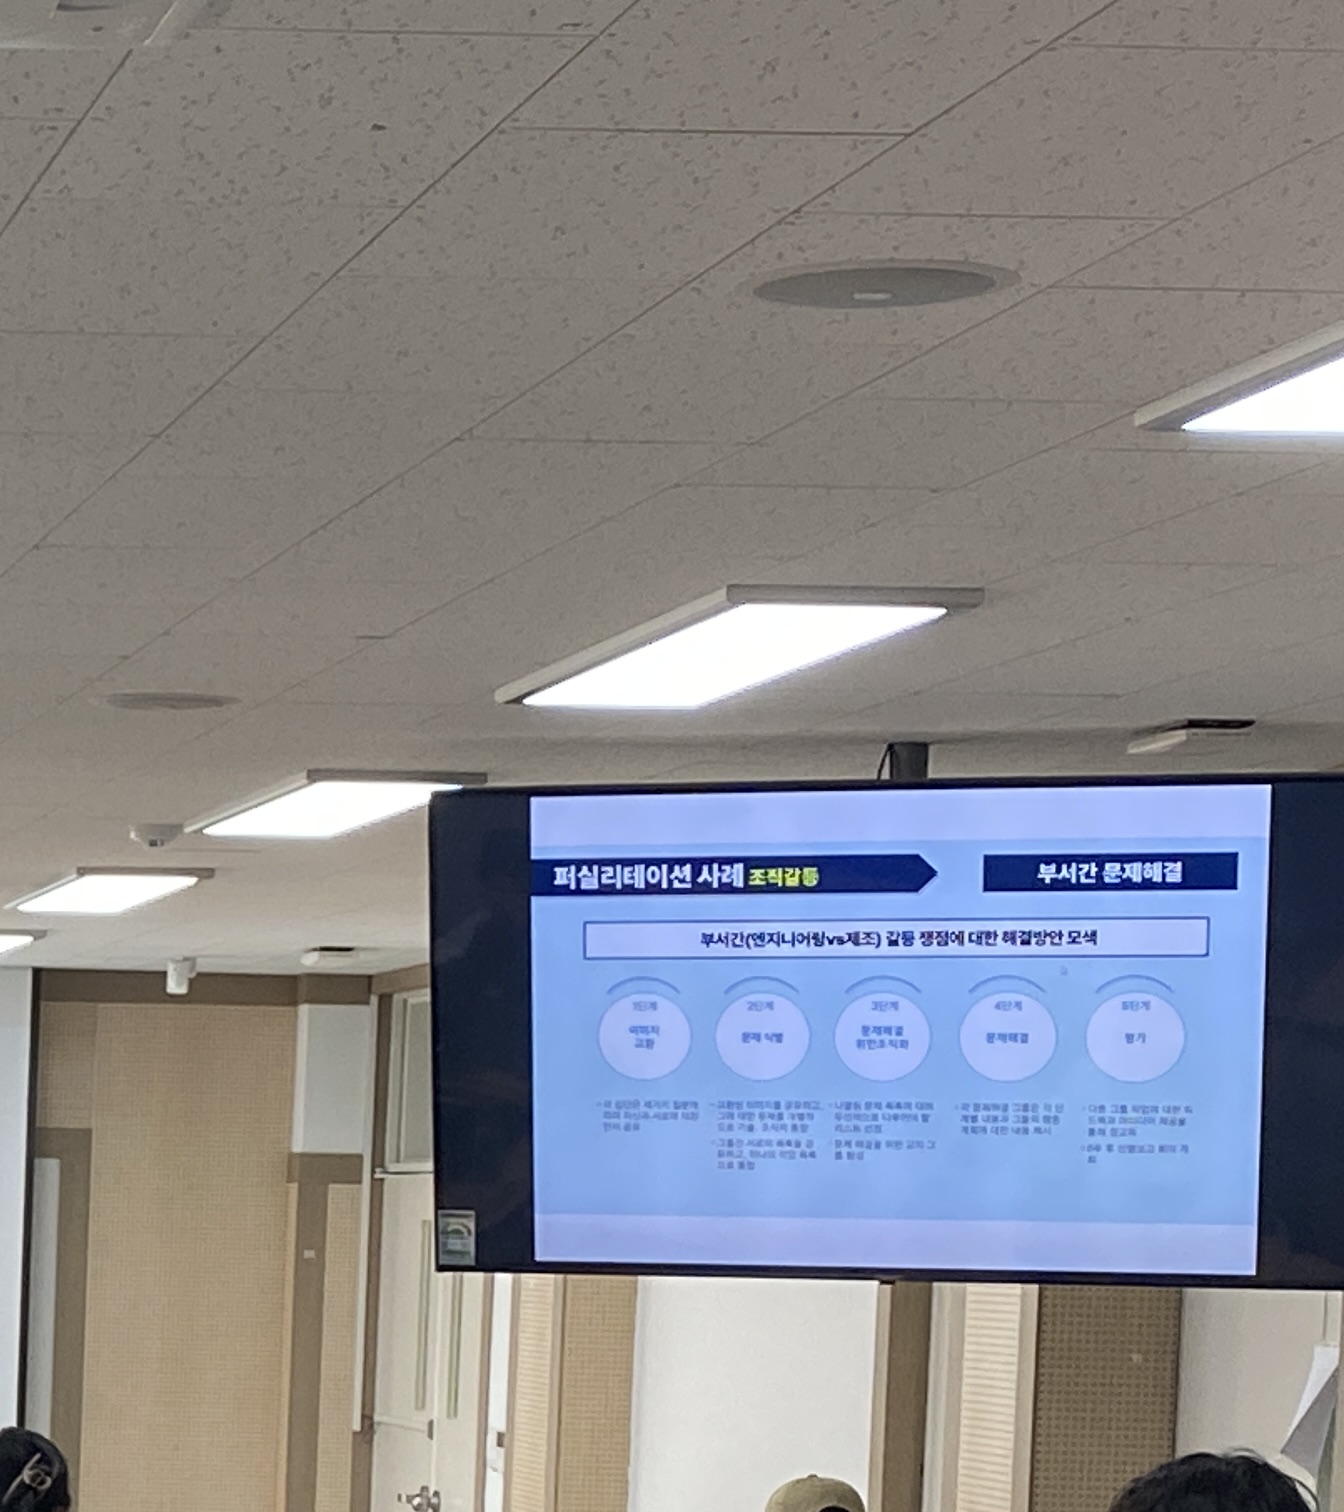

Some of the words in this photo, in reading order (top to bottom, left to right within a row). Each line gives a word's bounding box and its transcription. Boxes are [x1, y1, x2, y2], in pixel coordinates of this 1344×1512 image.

[553, 862, 693, 890] 퍼실리테이션
[696, 861, 745, 888] 사례
[748, 866, 820, 887] 조직갈등
[1036, 862, 1098, 884] 부서간
[1102, 861, 1184, 884] 문제해결
[886, 930, 915, 947] 갈등
[968, 930, 998, 947] 대한
[1002, 929, 1063, 948] 해결방안
[1066, 929, 1099, 947] 모색
